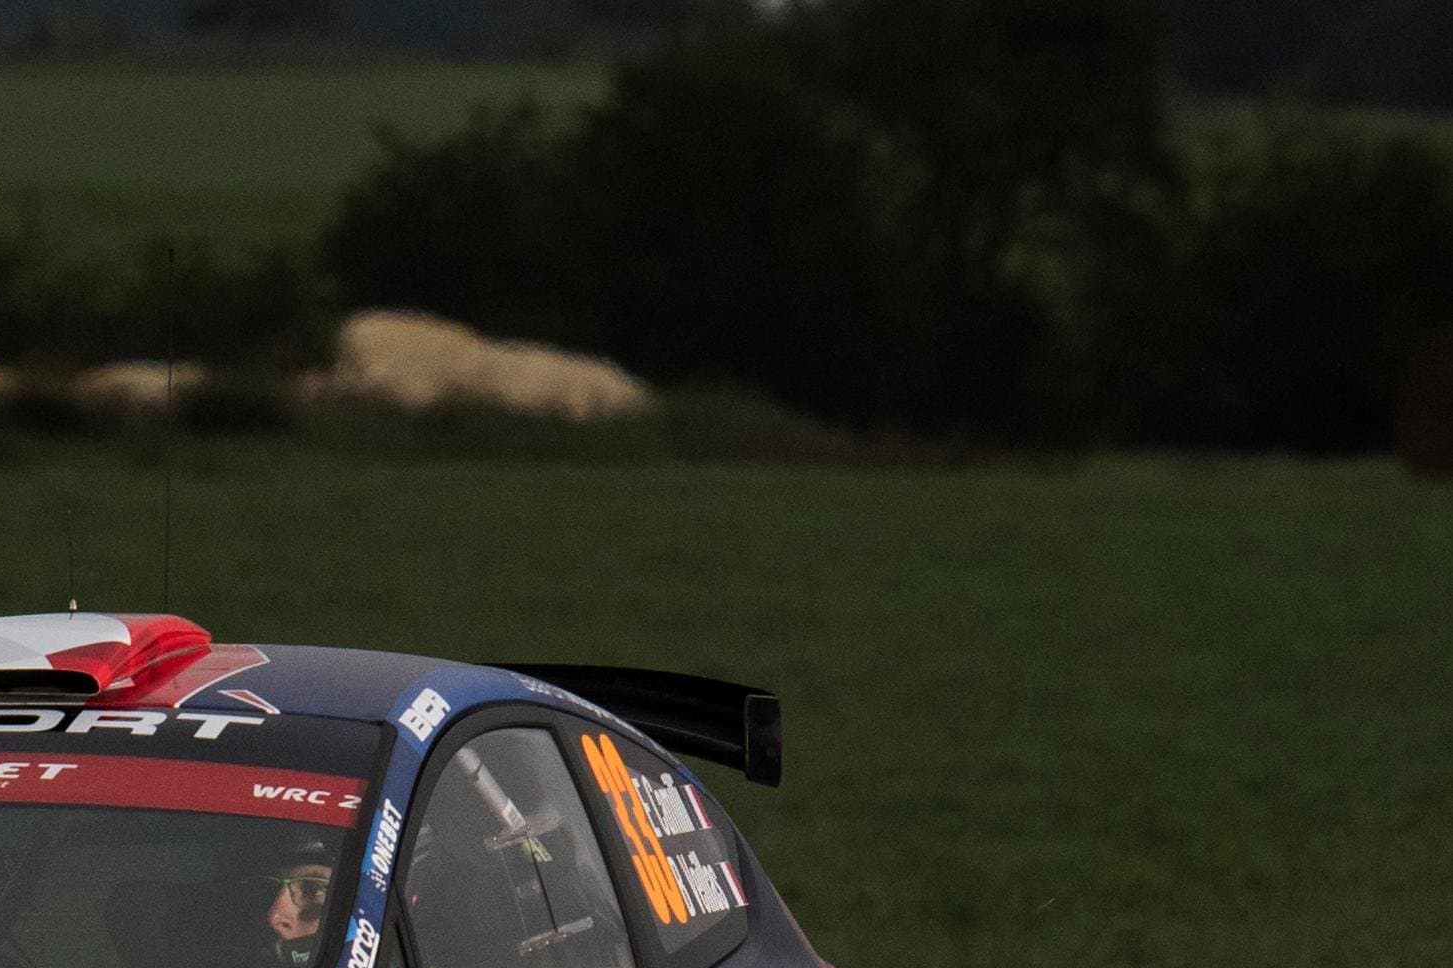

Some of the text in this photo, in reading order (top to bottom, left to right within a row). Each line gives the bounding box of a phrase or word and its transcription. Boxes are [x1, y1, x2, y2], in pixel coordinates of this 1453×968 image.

[252, 782, 362, 809] WRC 2
[372, 799, 404, 876] ONEBET
